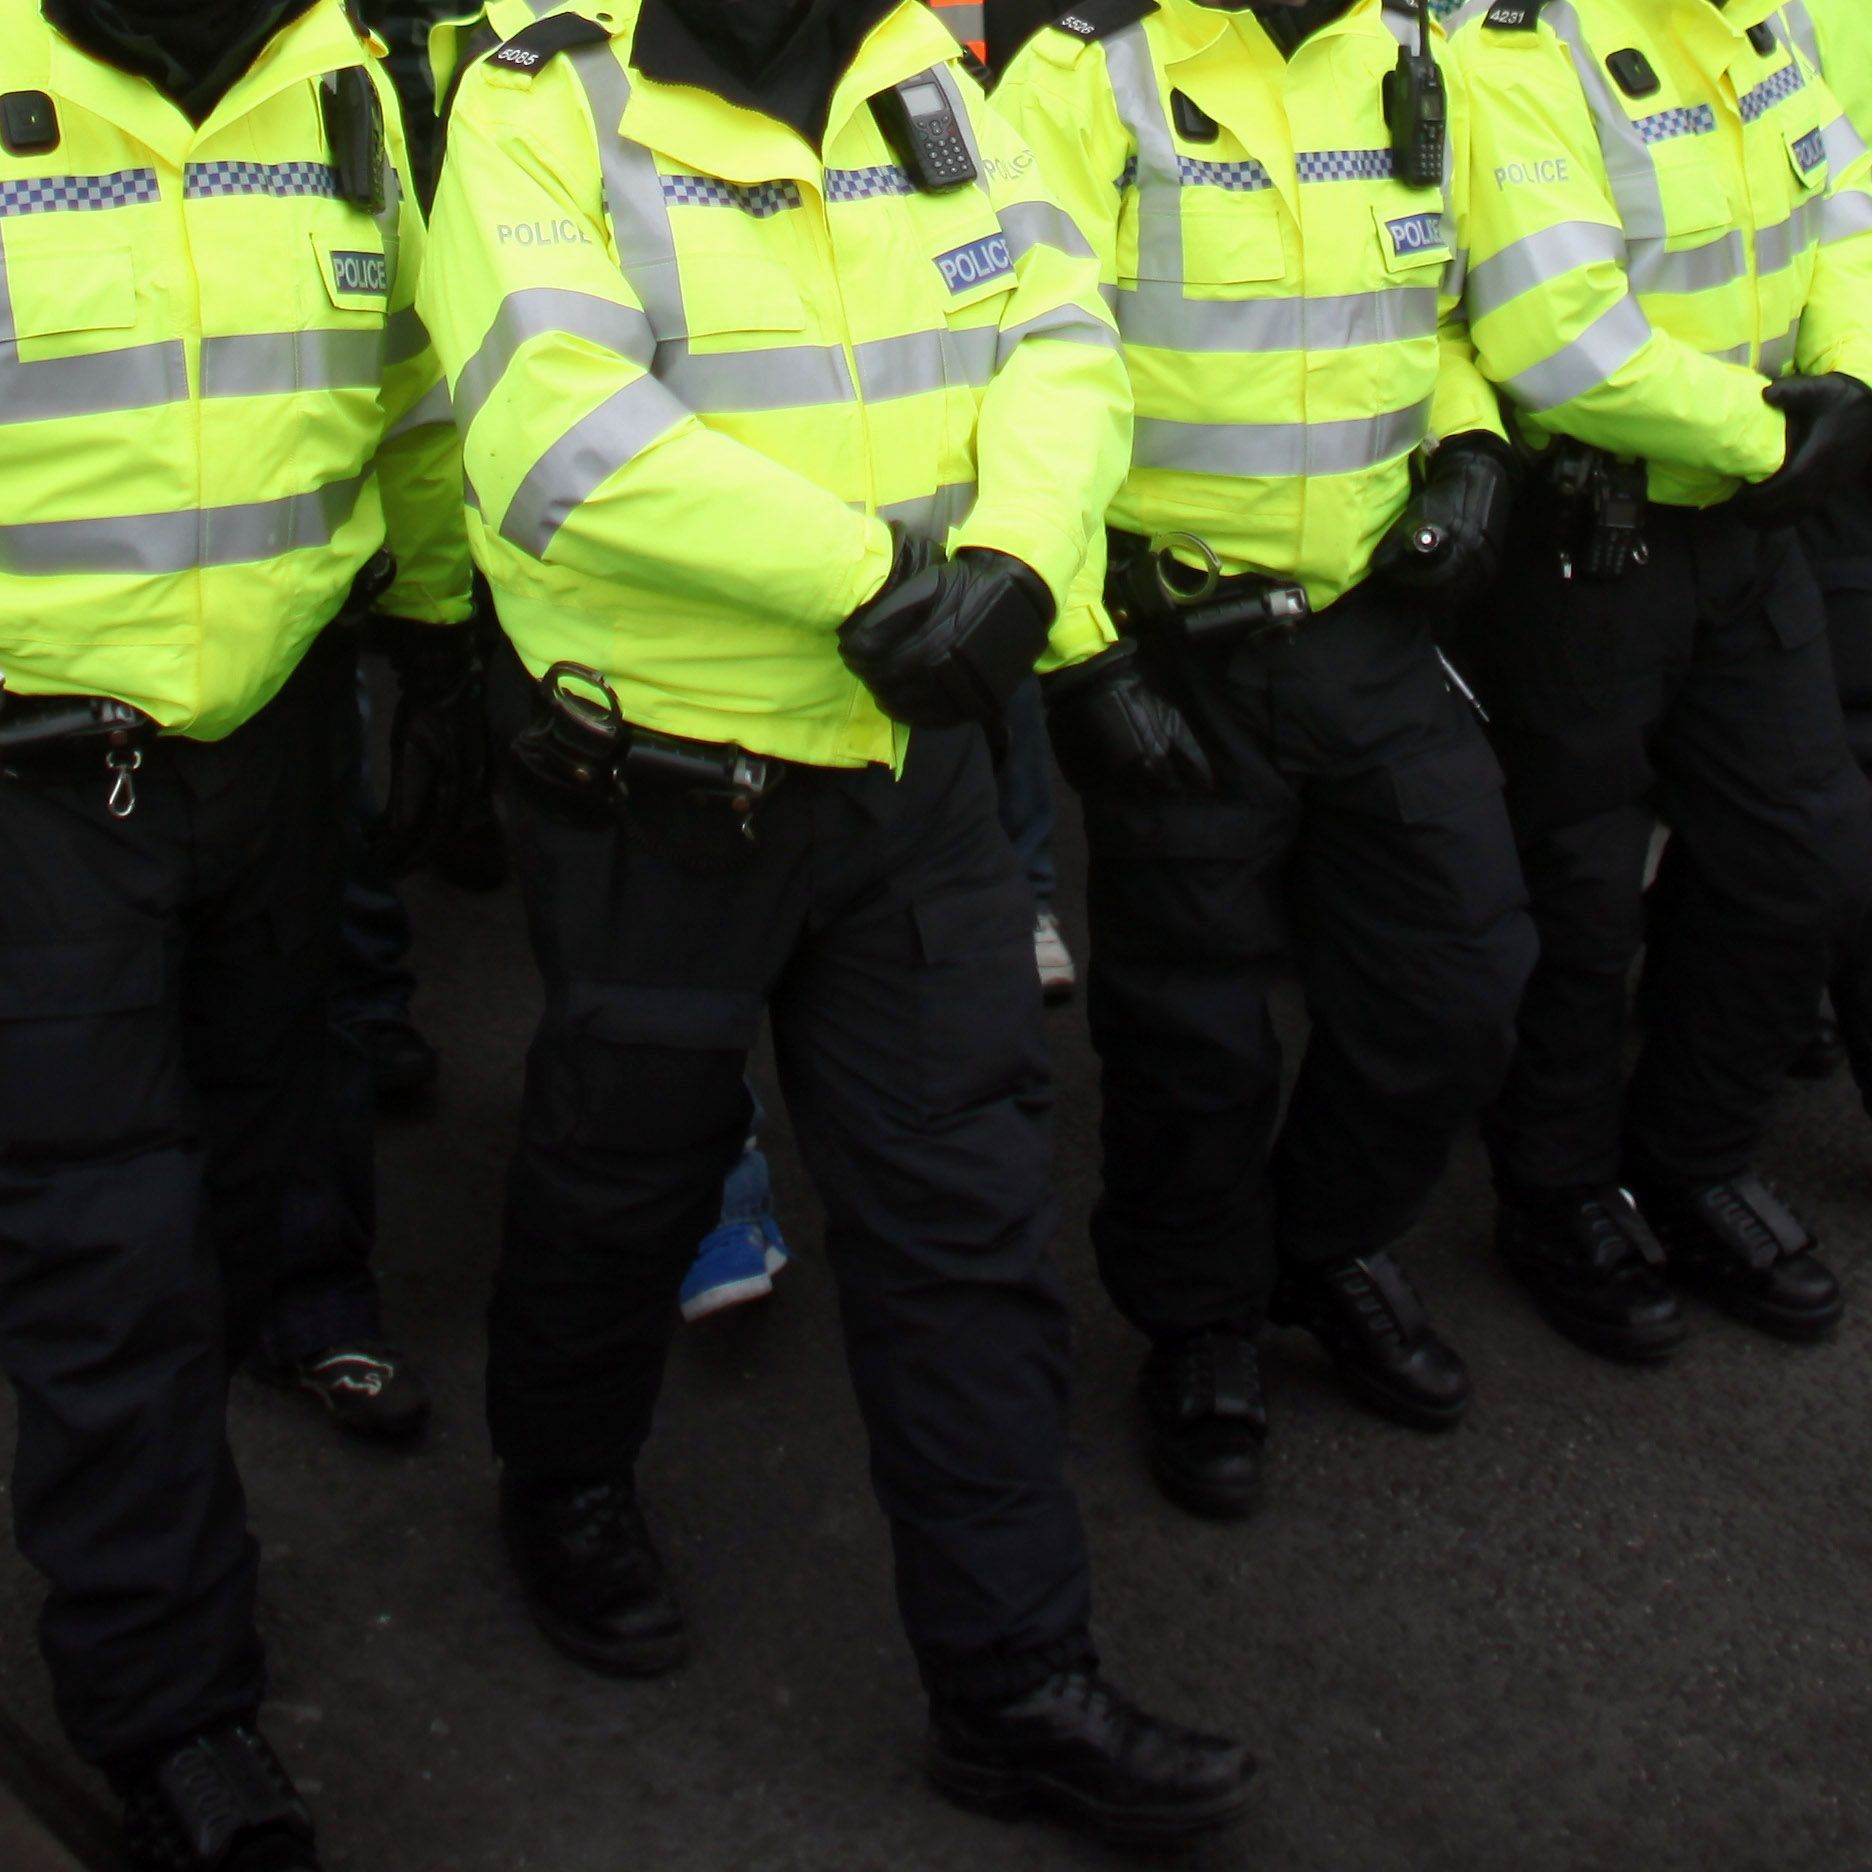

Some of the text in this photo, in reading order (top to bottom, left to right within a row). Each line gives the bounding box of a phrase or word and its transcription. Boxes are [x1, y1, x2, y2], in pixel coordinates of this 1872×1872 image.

[1490, 9, 1525, 25] 4231
[497, 48, 539, 66] 5085
[1494, 158, 1570, 192] POLICE
[333, 257, 386, 289] POLICE
